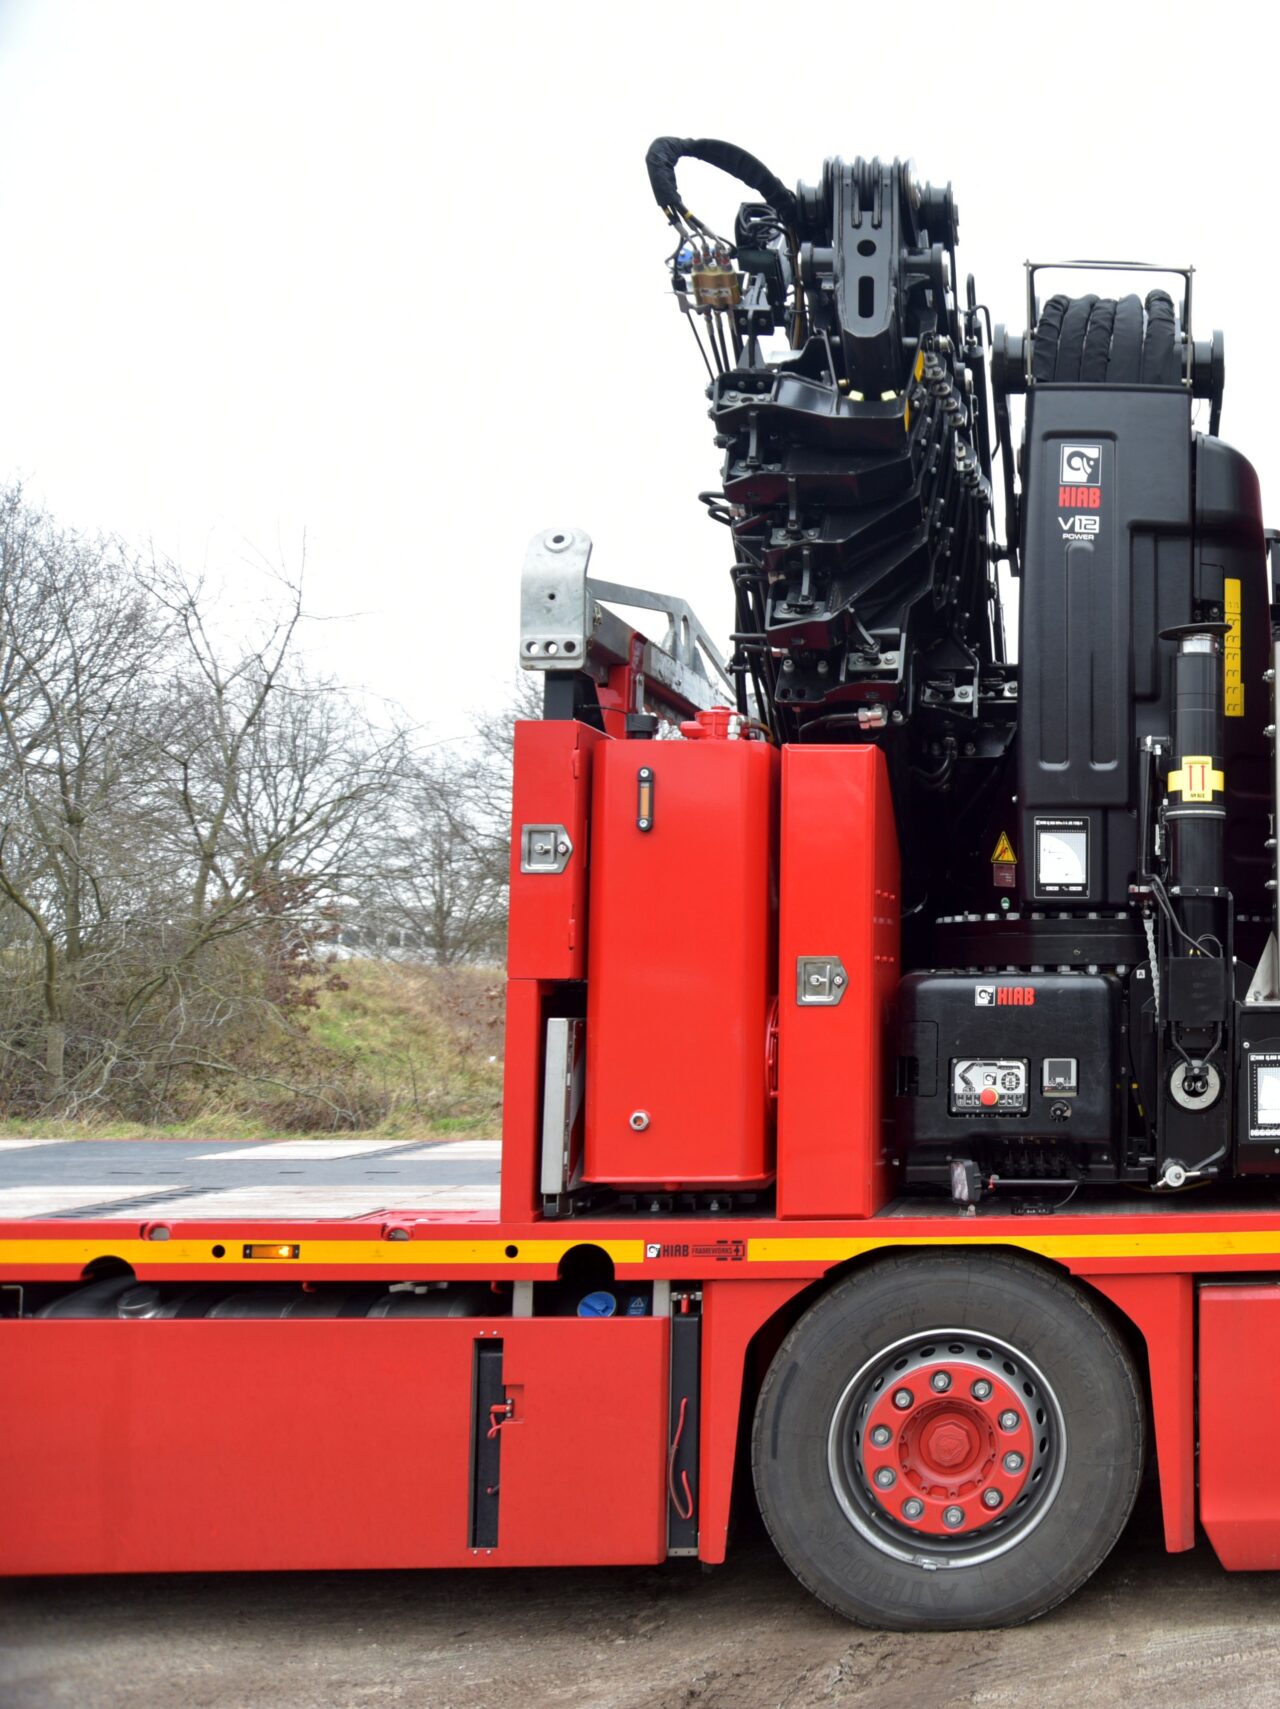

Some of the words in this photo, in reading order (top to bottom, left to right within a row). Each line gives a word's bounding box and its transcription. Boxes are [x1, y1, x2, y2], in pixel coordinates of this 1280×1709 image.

[1059, 486, 1101, 508] HIAB
[1058, 515, 1100, 533] V12
[1062, 533, 1095, 541] POWER
[997, 987, 1035, 1006] HIAB
[663, 1244, 689, 1257] HIAB
